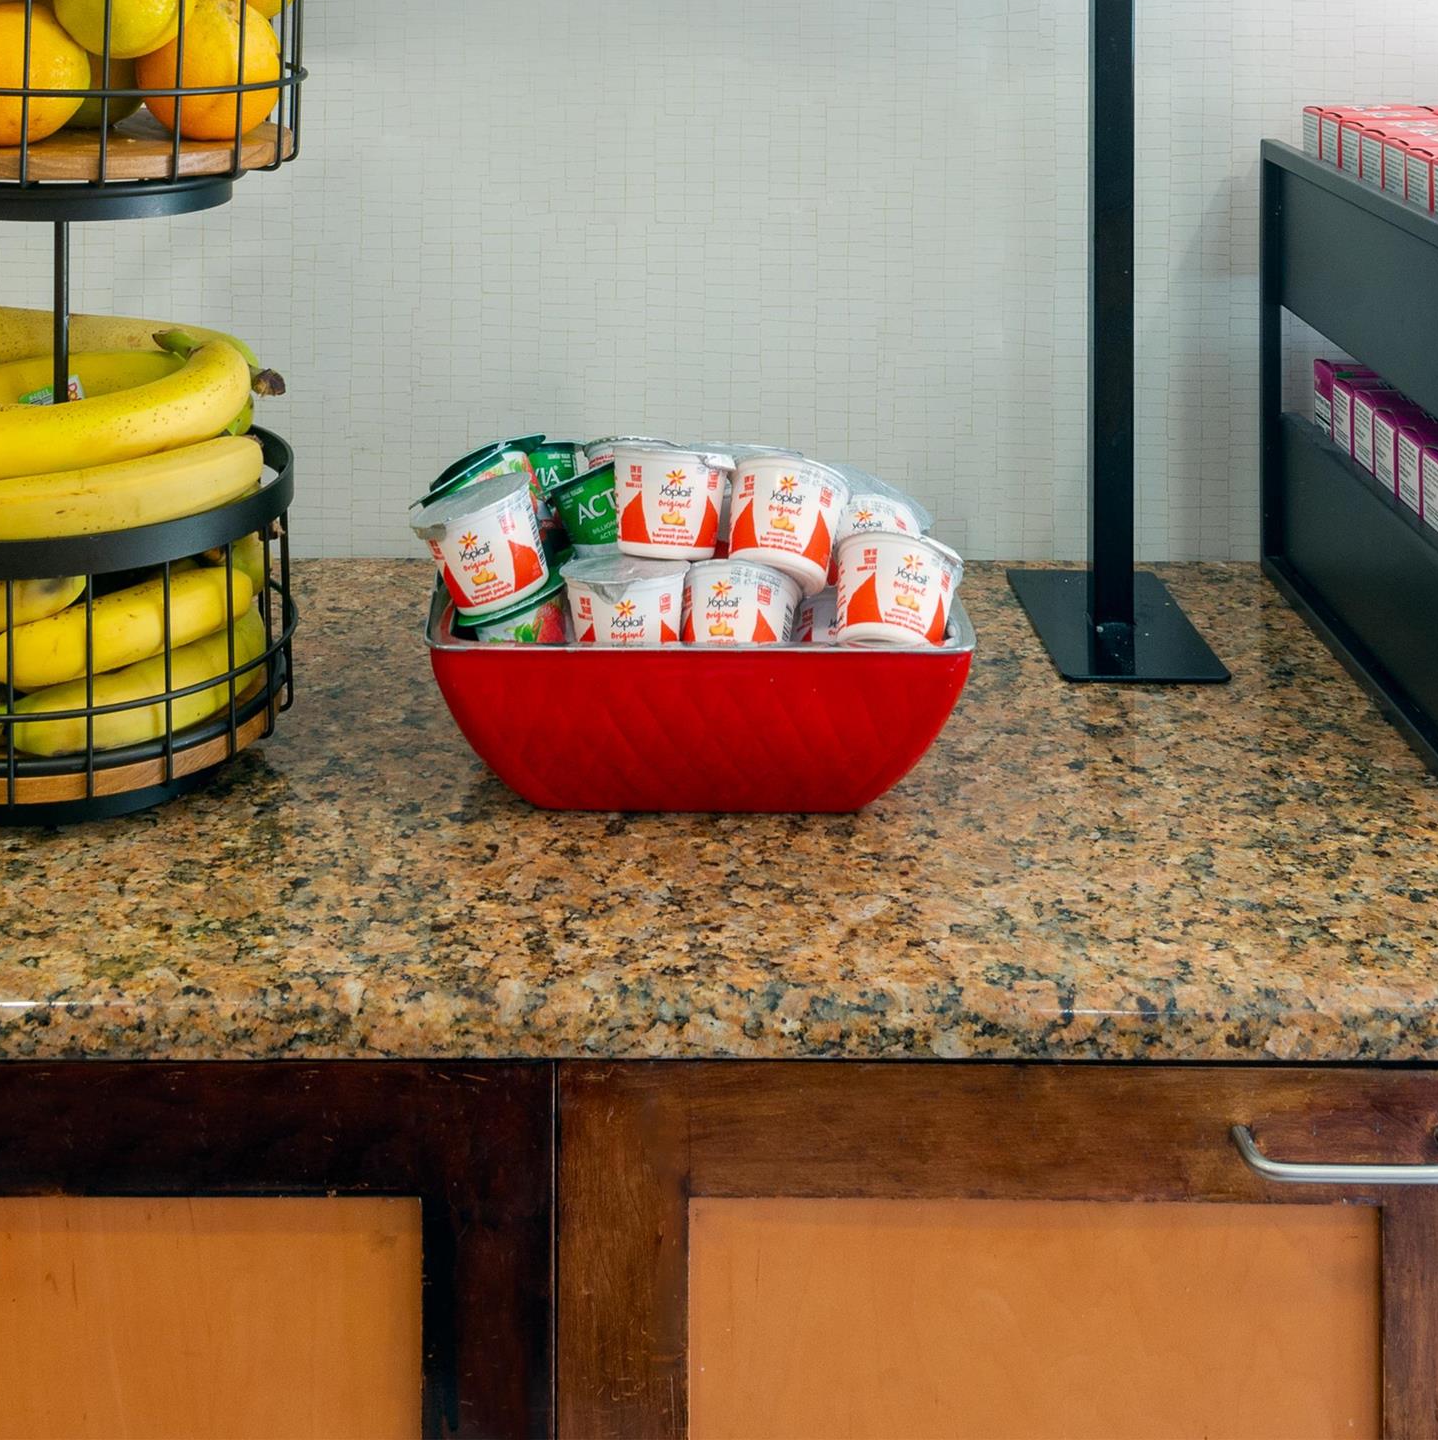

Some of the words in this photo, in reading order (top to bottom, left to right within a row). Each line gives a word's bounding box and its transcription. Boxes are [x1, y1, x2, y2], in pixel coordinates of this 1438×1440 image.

[659, 485, 692, 499] Yoplait
[770, 490, 802, 505] Yoplait
[578, 488, 616, 526] ACT
[852, 521, 882, 530] Yoplait
[459, 541, 489, 561] Yoplait
[895, 566, 927, 585] Yoplait
[706, 597, 738, 610] Yoplait
[611, 617, 644, 631] Yoplait
